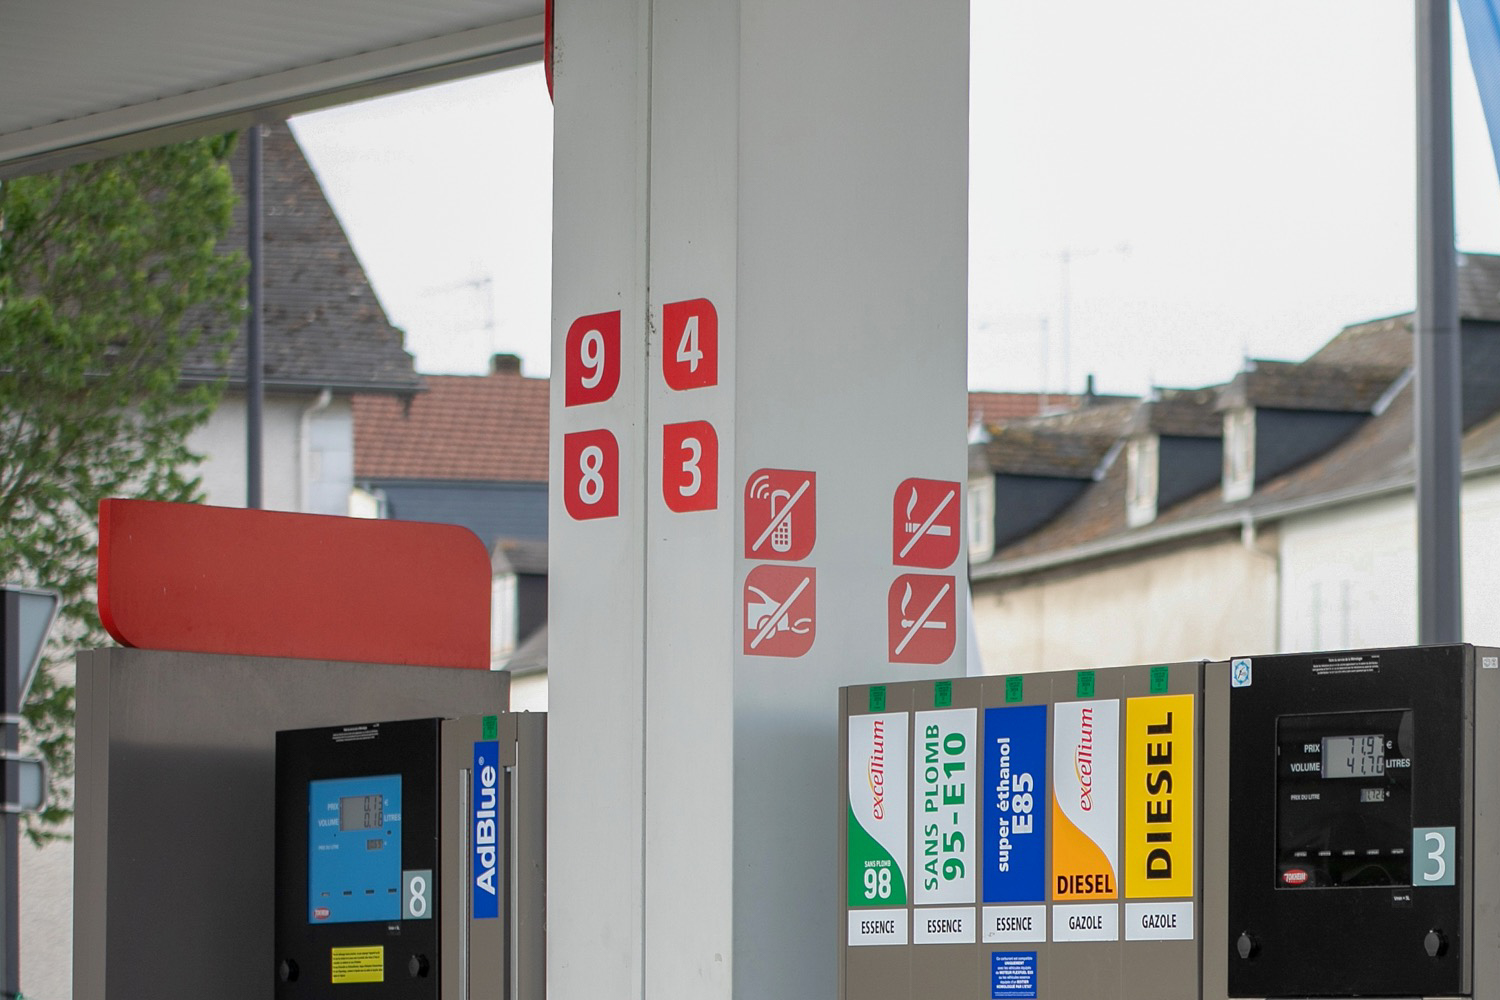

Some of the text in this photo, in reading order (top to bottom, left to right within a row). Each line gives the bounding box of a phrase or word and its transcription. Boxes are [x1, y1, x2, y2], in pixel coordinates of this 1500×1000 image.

[580, 329, 606, 389] 9
[676, 315, 703, 373] 4
[579, 445, 604, 504] 8
[679, 437, 702, 497] 3
[870, 720, 885, 820] excellium
[1076, 707, 1093, 812] excellium
[1290, 763, 1320, 772] VOLUME
[1386, 758, 1411, 768] LITRES
[1304, 744, 1320, 753] PRIX
[925, 724, 939, 891] SANS PLOMB
[997, 737, 1010, 873] super éthanol
[1012, 772, 1033, 834] E85
[1146, 712, 1173, 880] DIESEL
[1423, 831, 1446, 882] 3
[409, 876, 426, 918] 8
[864, 868, 891, 899] 98
[1057, 874, 1113, 894] DIESEL
[861, 920, 895, 935] ESSENCE
[927, 919, 962, 933] ESSENCE
[996, 917, 1032, 931] ESSENCE
[1068, 915, 1102, 931] GAZOLE
[1142, 914, 1177, 929] GAZOLE
